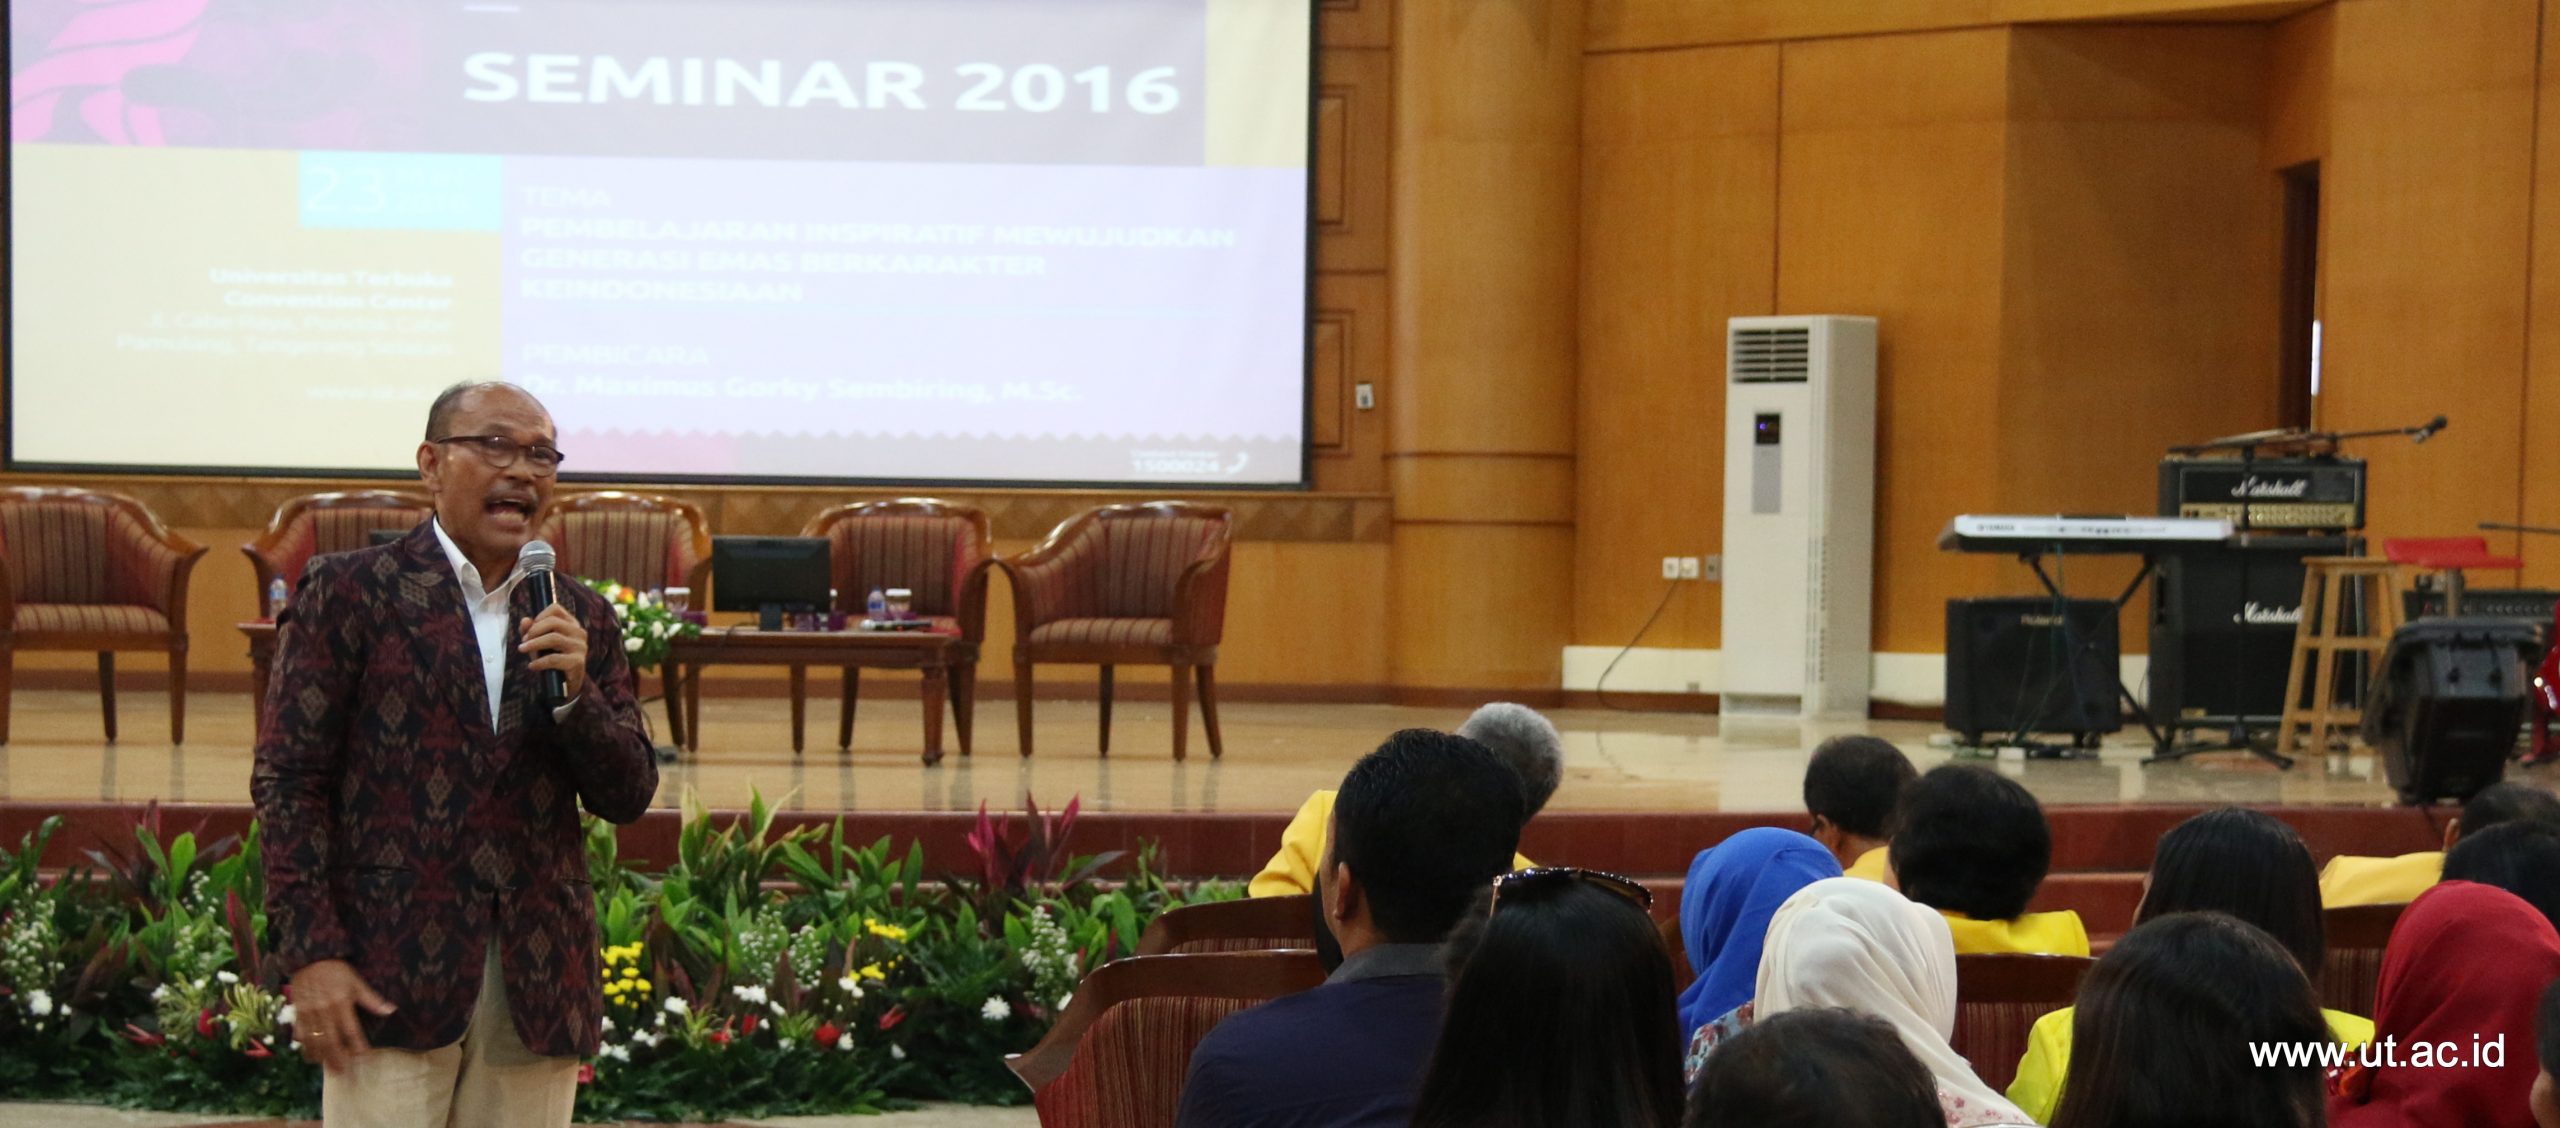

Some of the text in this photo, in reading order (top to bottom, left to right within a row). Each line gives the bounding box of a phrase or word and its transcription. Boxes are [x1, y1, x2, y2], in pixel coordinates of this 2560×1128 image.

[463, 52, 1181, 115] SEMINAR 2016
[303, 166, 386, 213] 23
[520, 185, 612, 208] TEMA
[520, 217, 1235, 247] PEMBELAJARAN INSPIRATIF MEWUJUDKAN
[520, 248, 1047, 276] GENERASI EMAS BERKARAKTER
[208, 267, 454, 288] Universitas Terbuka
[223, 289, 452, 310] Convention Center
[520, 278, 805, 303] KEINDONESIAAN
[521, 343, 710, 367] PEMBICARA
[523, 374, 1086, 405] Dr. Maximus Gorky Sembiring, M.Sc.
[2231, 475, 2309, 498] Marshall
